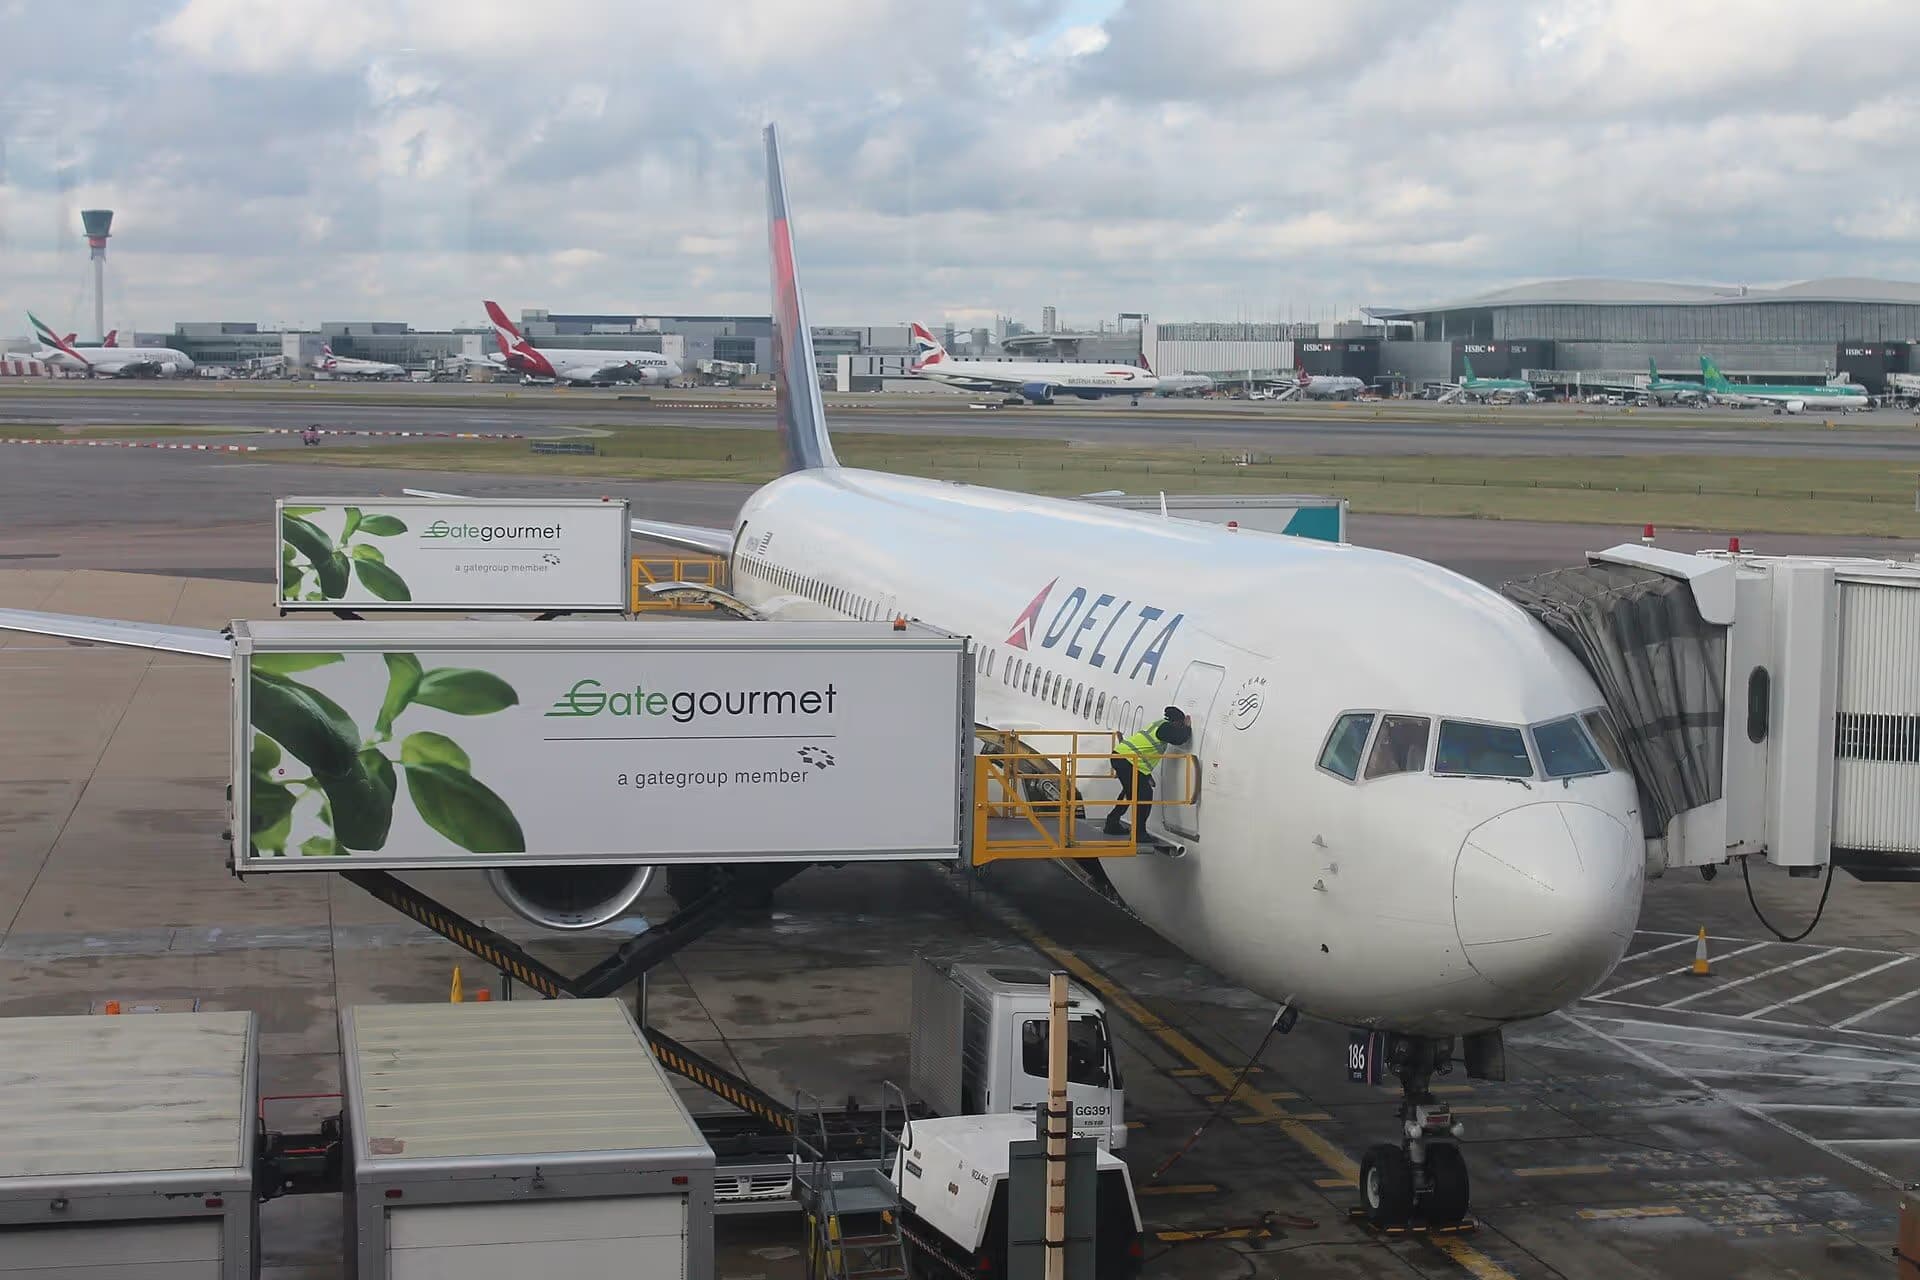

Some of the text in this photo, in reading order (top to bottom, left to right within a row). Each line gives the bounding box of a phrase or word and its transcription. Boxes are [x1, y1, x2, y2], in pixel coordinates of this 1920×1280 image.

[1303, 343, 1323, 352] HSBC
[1464, 344, 1486, 353] HSBC
[420, 520, 562, 542] Gategourmet
[455, 562, 548, 575] a gategroup member
[1041, 586, 1185, 686] DELTA
[543, 679, 837, 723] Gategourmet
[617, 768, 809, 788] a gategroup member
[1349, 1044, 1365, 1070] 186
[1075, 1106, 1111, 1116] GG391
